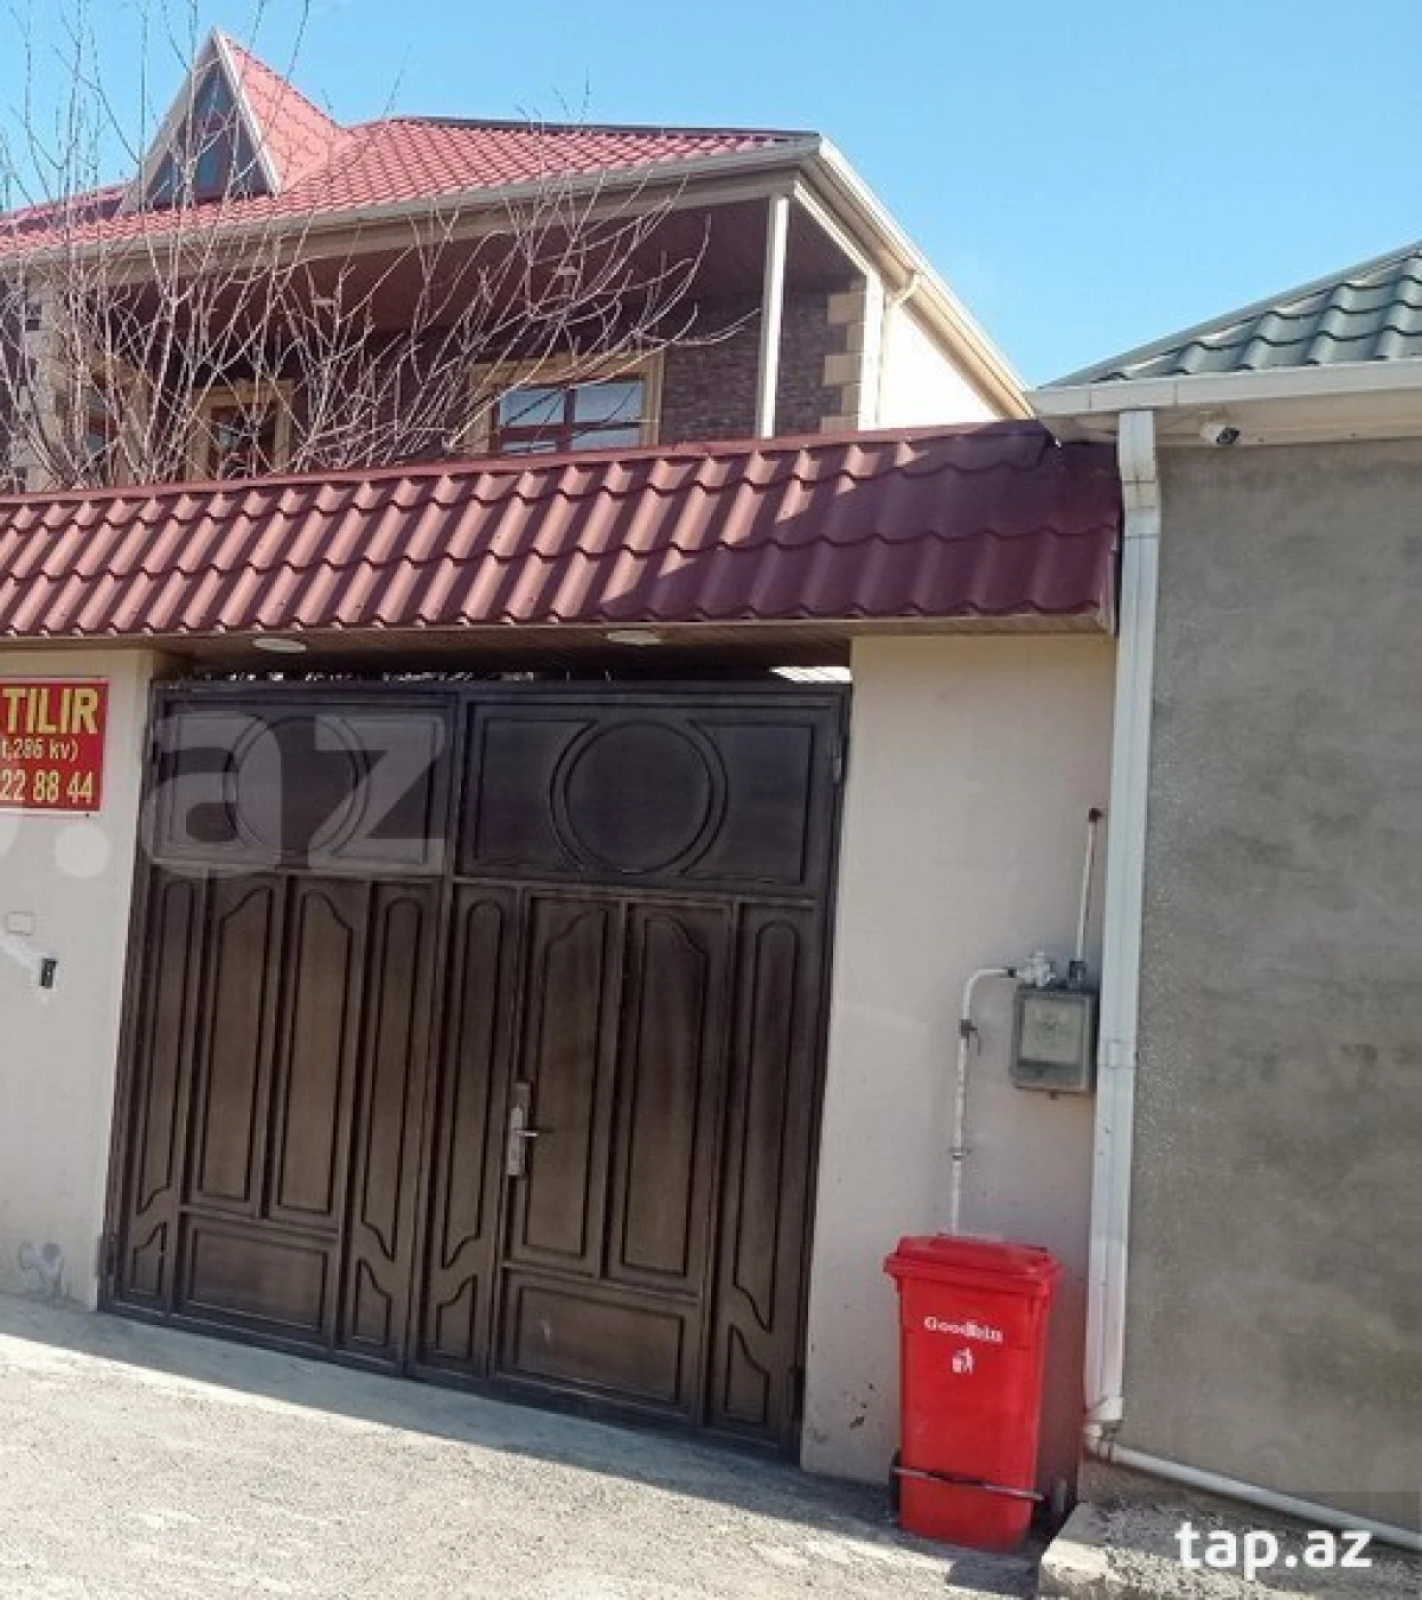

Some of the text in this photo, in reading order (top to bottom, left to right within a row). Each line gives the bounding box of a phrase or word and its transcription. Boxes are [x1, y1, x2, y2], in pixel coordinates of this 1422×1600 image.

[48, 738, 79, 762] kv)
[32, 769, 60, 804] 88
[66, 771, 93, 804] 44
